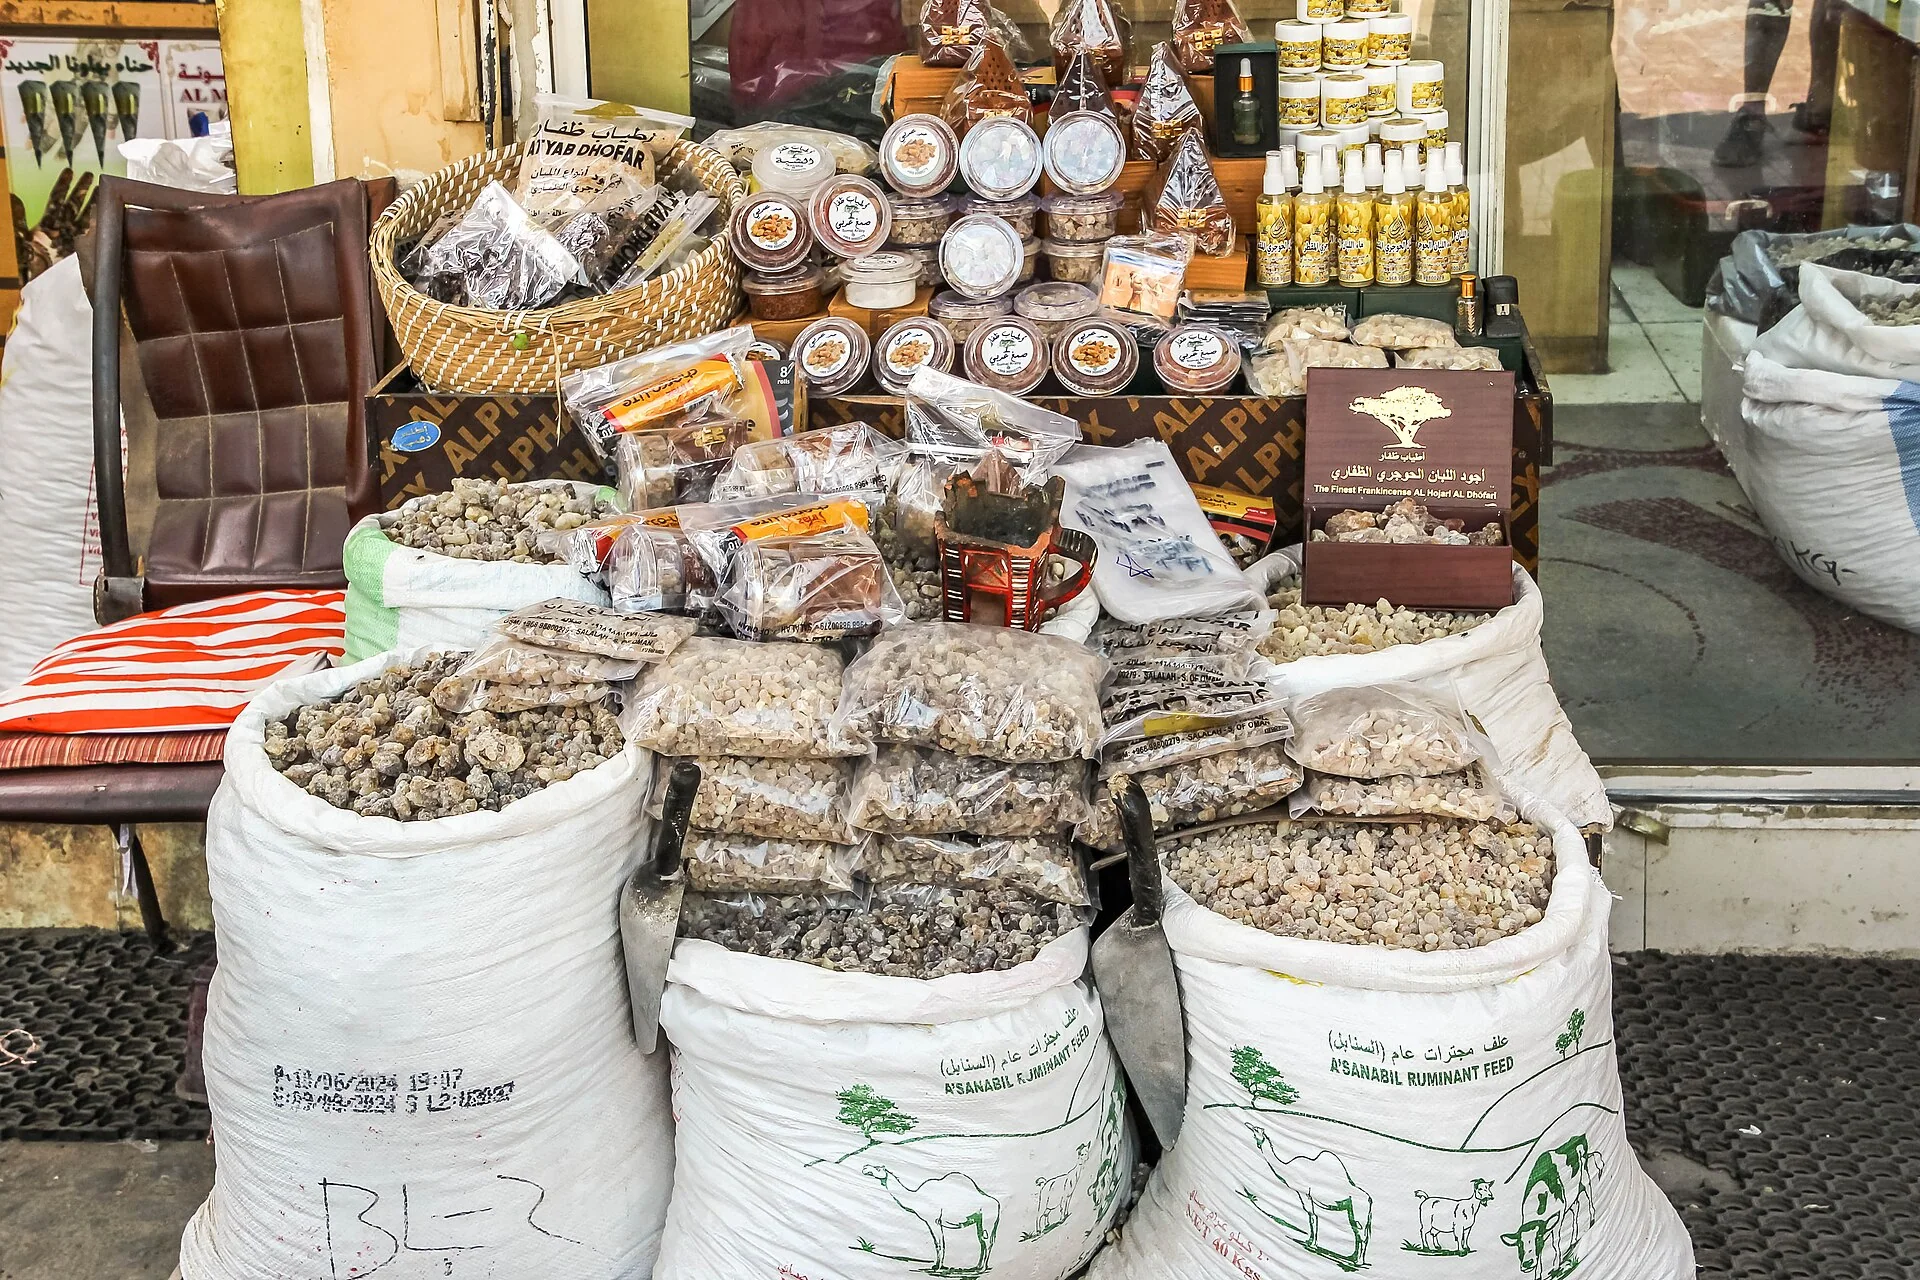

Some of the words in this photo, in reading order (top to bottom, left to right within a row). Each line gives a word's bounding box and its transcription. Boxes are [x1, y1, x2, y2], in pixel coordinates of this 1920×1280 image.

[179, 87, 208, 103] AL
[211, 87, 228, 103] M
[527, 139, 577, 158] ATYAB
[577, 143, 645, 170] DHOFAR
[835, 220, 854, 232] عربي
[855, 218, 871, 230] صمغ
[989, 354, 1008, 366] عربي
[1011, 350, 1028, 362] صمغ
[779, 365, 788, 379] 8
[777, 378, 791, 386] rolls
[1378, 451, 1400, 463] ظفار
[1330, 464, 1372, 480] الظفاري
[1376, 467, 1424, 483] الحوجري
[1427, 468, 1457, 483] اللبان
[1460, 468, 1486, 484] أجود
[1314, 484, 1329, 493] The
[1331, 484, 1356, 494] Finest
[1358, 486, 1412, 496] Frankincense
[1414, 488, 1426, 497] AL
[1453, 490, 1465, 498] AL
[1144, 670, 1177, 681] SALALAH
[1236, 722, 1247, 731] OF
[1247, 718, 1271, 730] OMAN
[1062, 1007, 1080, 1029] علف
[1483, 1034, 1510, 1052] علف
[1001, 1050, 1022, 1071] عام
[1391, 1045, 1416, 1066] عام
[1424, 1044, 1474, 1064] مجترات
[1330, 1056, 1404, 1087] A'SANABIL
[1407, 1065, 1480, 1088] RUMINANT
[1484, 1056, 1515, 1079] FEED
[944, 1075, 1015, 1096] A'SANABIL
[1212, 1237, 1229, 1258] 40
